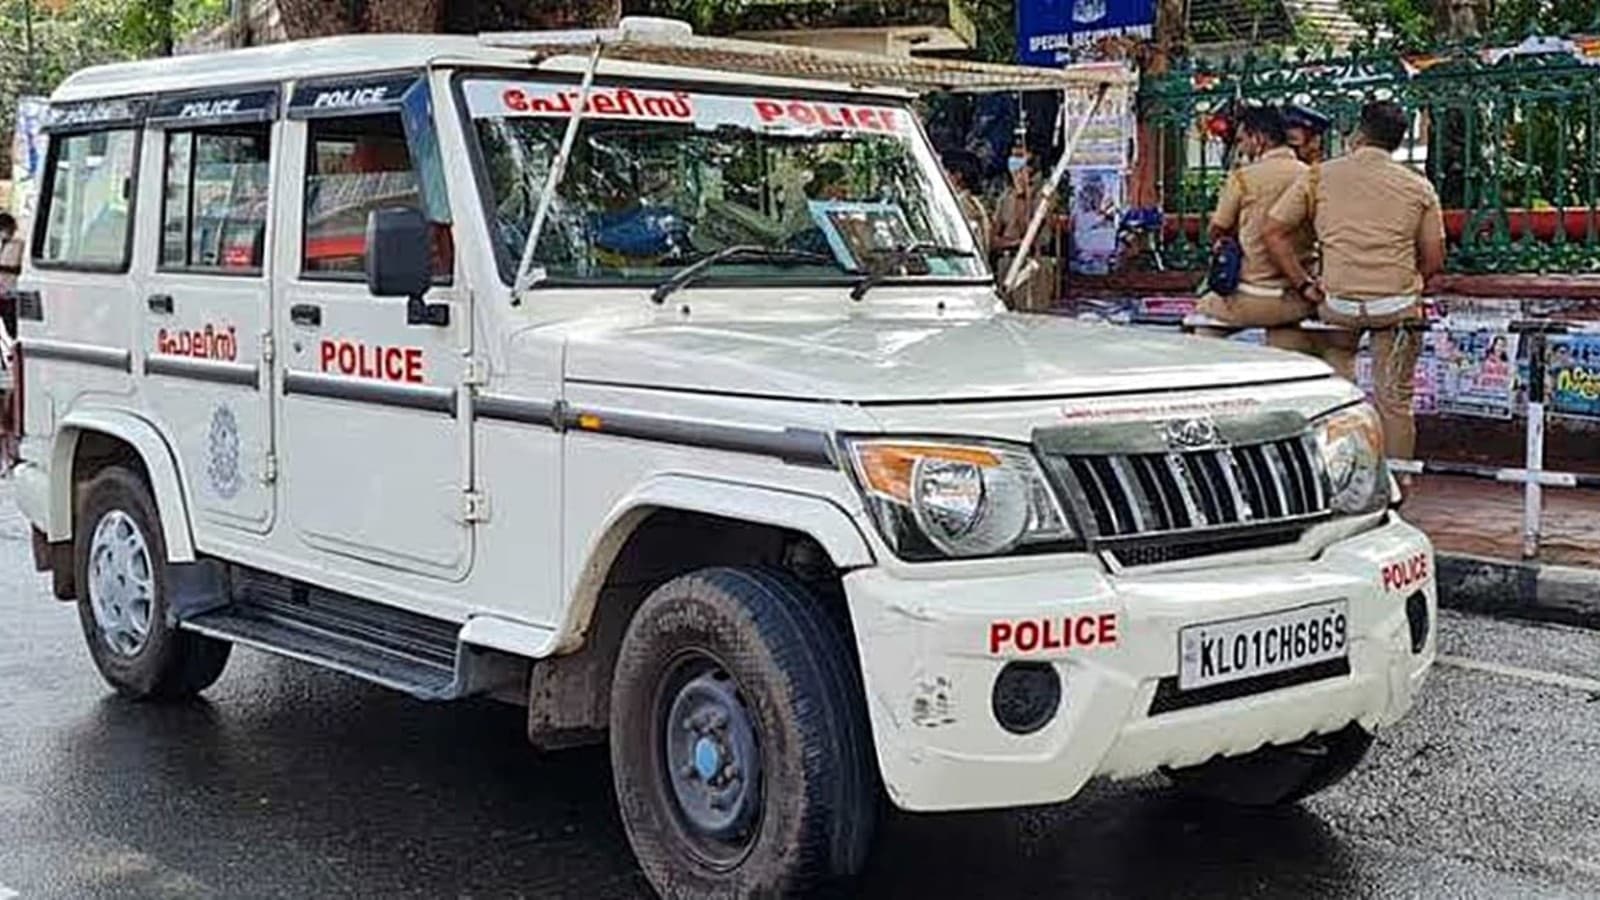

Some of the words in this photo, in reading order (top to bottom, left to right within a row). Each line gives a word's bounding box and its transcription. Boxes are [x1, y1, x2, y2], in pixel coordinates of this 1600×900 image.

[1029, 33, 1069, 52] SPECIAL
[179, 99, 241, 119] POLICE
[313, 86, 388, 108] POLICE
[754, 101, 897, 131] POLICE
[320, 340, 423, 383] POLICE
[1382, 553, 1427, 592] POLICE
[990, 613, 1117, 654] POLICE
[1200, 613, 1347, 678] KL01CH6869
